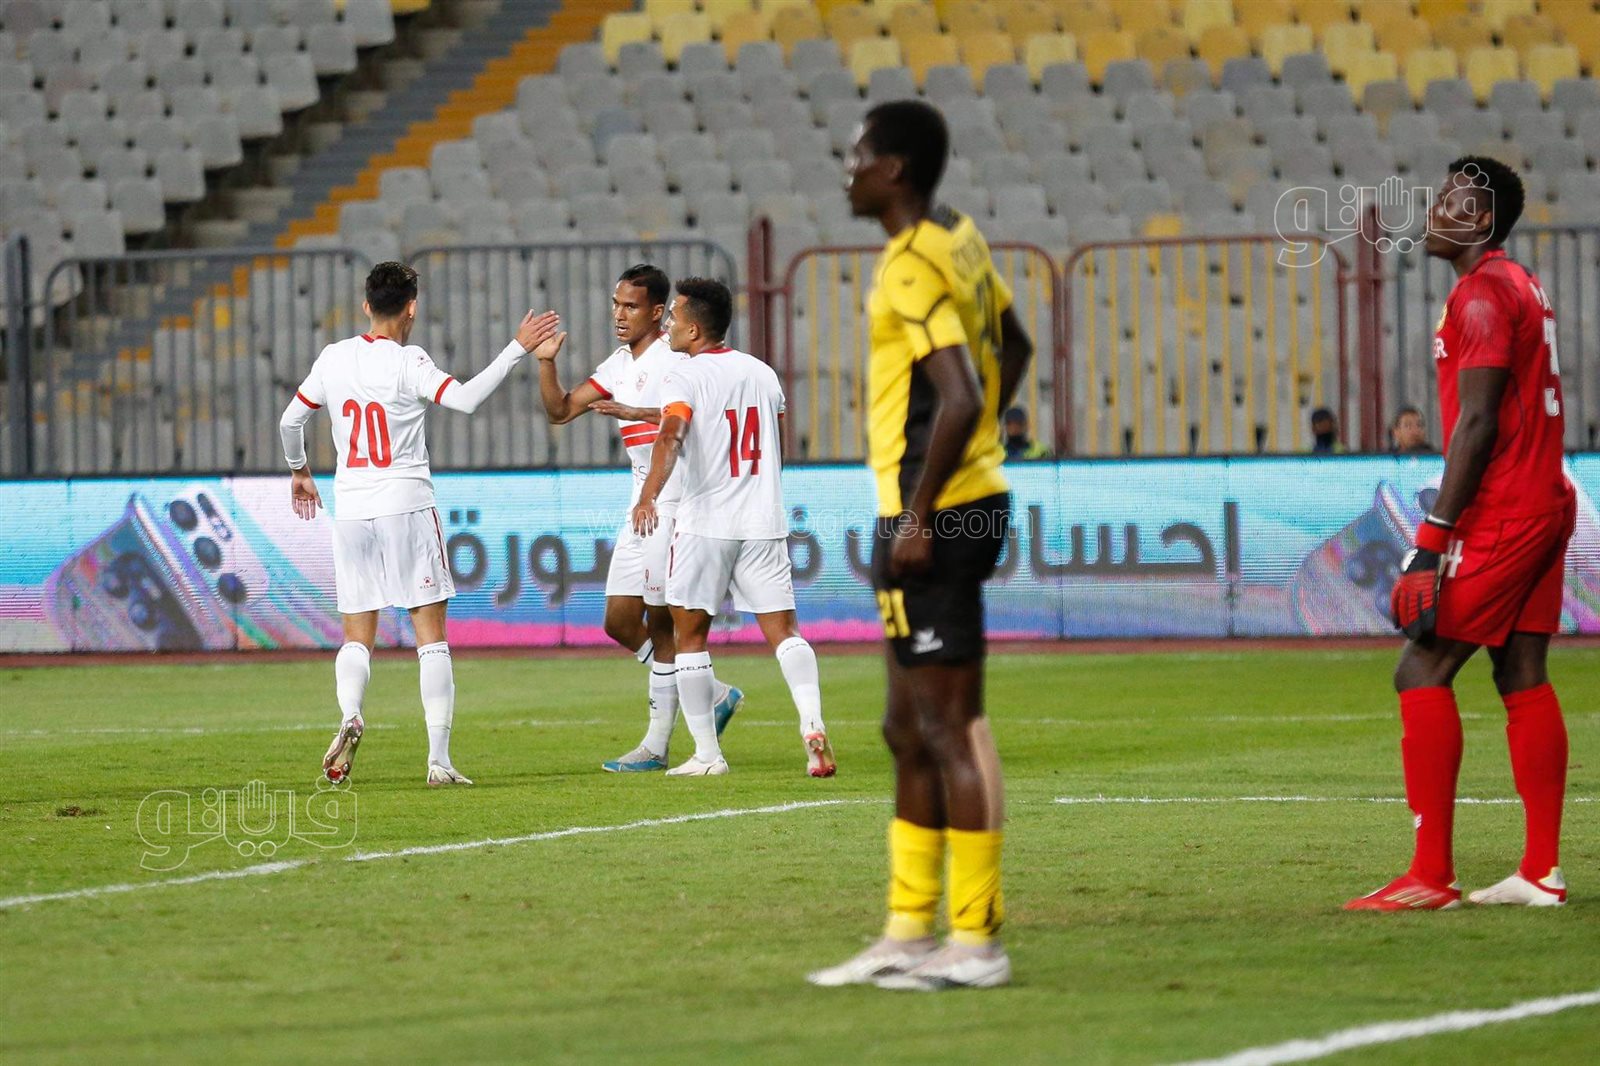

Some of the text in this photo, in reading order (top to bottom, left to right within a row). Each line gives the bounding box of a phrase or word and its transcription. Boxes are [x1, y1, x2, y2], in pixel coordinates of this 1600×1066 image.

[342, 399, 392, 468] 20
[725, 406, 762, 477] 14
[680, 663, 709, 672] KELME
